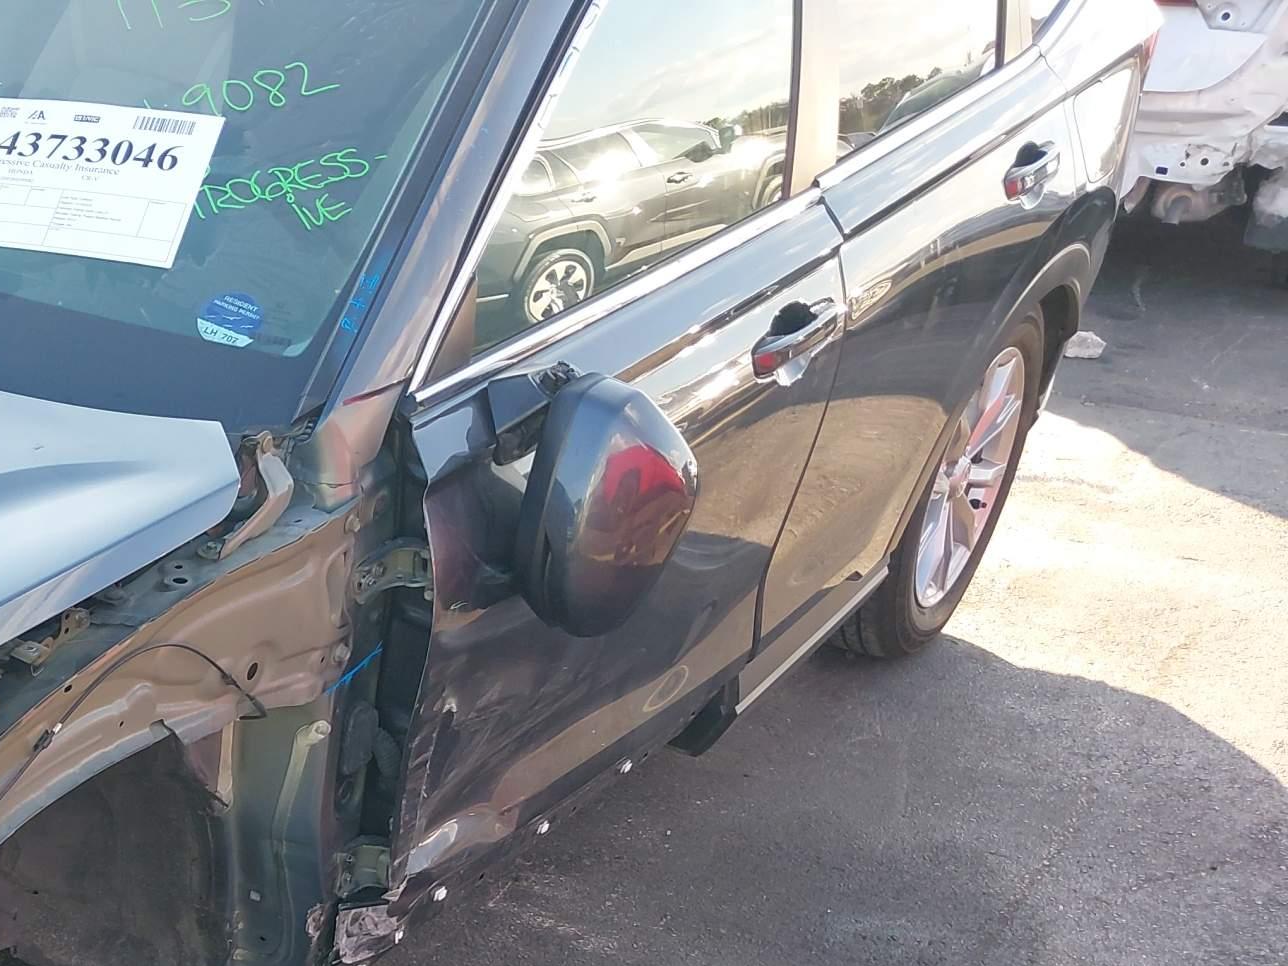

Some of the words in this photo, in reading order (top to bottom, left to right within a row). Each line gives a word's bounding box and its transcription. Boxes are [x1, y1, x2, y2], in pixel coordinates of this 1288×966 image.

[32, 160, 72, 173] Casualty
[74, 163, 120, 176] Insurance
[213, 299, 238, 312] PARKING
[224, 295, 259, 313] RESIDENT
[203, 326, 218, 337] LH
[222, 333, 239, 344] 707
